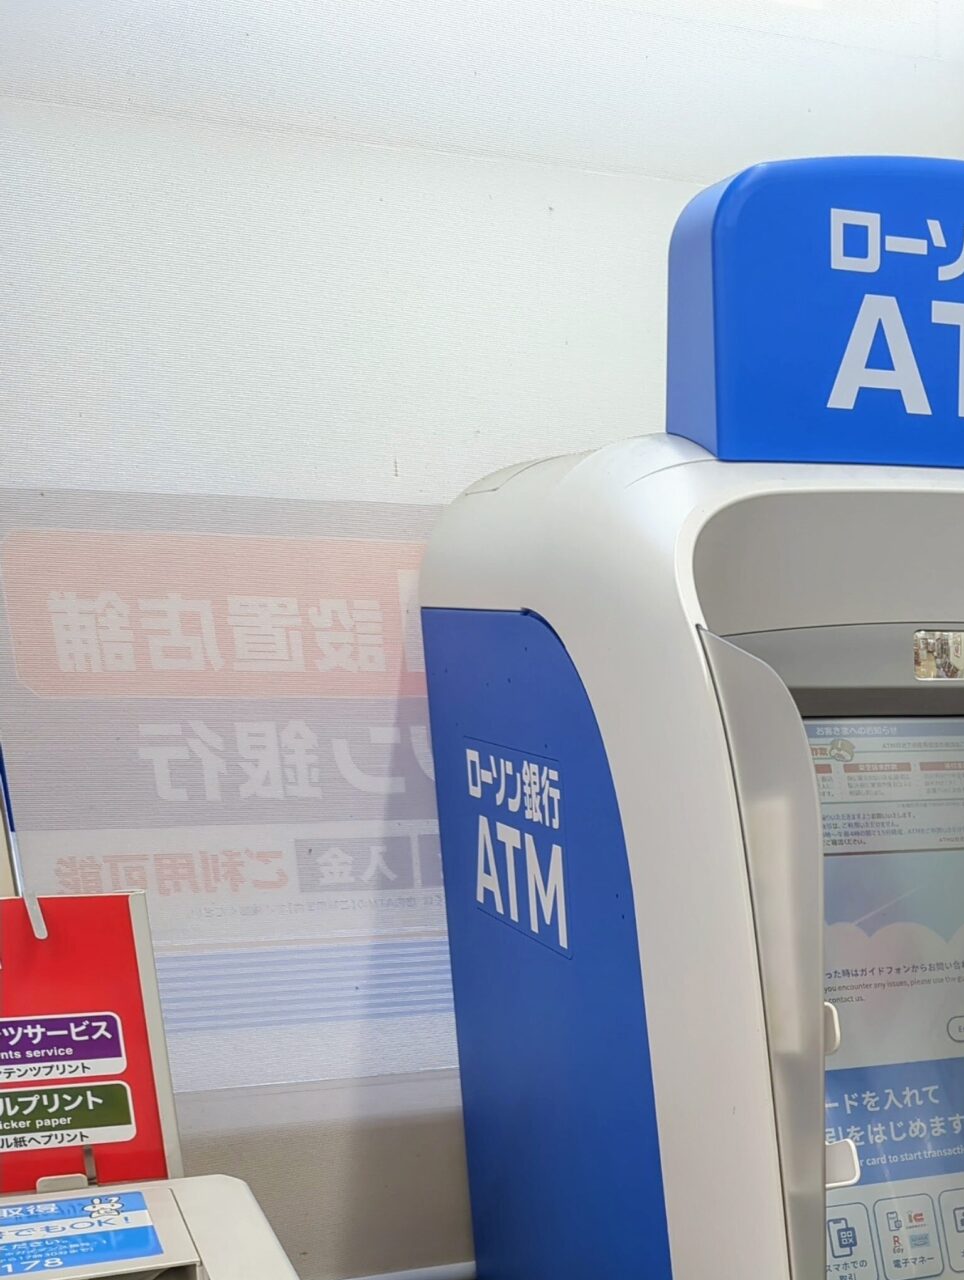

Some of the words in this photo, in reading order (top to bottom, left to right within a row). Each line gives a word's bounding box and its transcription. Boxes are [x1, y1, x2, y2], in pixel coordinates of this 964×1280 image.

[466, 747, 561, 830] ローソン銀行
[475, 814, 568, 950] ATM
[0, 1020, 112, 1046] ツサービス
[0, 1050, 22, 1060] nts
[26, 1046, 73, 1058] service
[0, 1062, 91, 1079] テンツプリント
[0, 1090, 103, 1117] ルプリント
[825, 1084, 940, 1114] ードを入れて
[0, 1118, 31, 1130] icker
[35, 1115, 72, 1129] paper
[866, 1153, 887, 1167] card
[888, 1152, 898, 1163] to
[900, 1149, 922, 1163] start
[0, 1216, 132, 1239] でもOK!
[826, 1259, 868, 1273] スマホでの
[893, 1256, 935, 1269] 電子マネー
